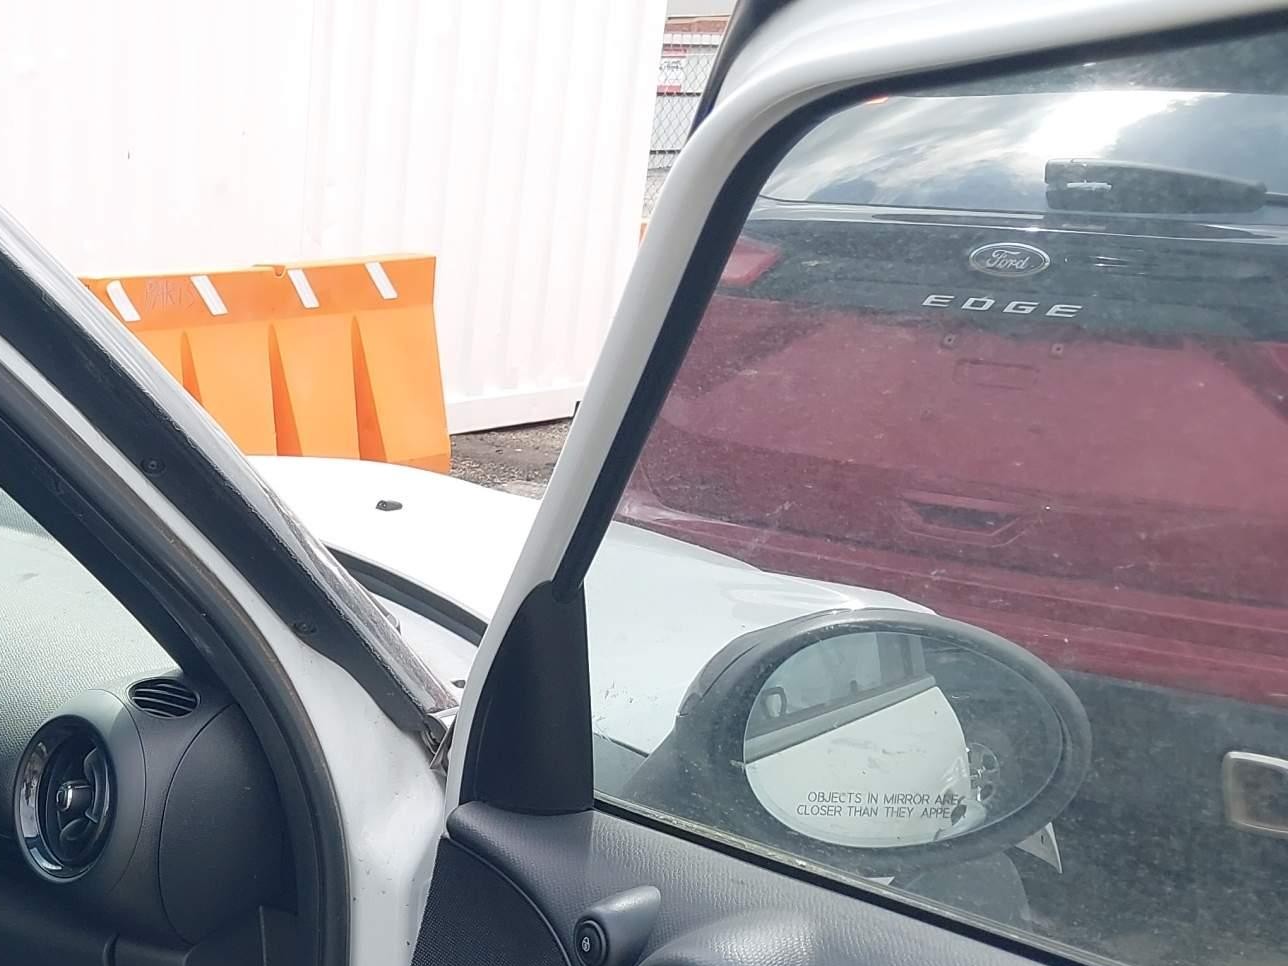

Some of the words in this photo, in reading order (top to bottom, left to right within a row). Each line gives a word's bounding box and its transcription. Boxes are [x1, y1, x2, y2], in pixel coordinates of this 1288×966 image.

[985, 249, 1030, 270] Ford
[922, 294, 1083, 318] EDGE
[807, 791, 862, 804] OBJECTS
[867, 792, 879, 804] IN
[883, 793, 930, 805] MIRROR
[934, 794, 959, 806] ARE
[796, 804, 843, 817] CLOSER
[847, 805, 879, 817] THAN
[884, 806, 914, 818] THEY
[920, 807, 966, 819] APPE
